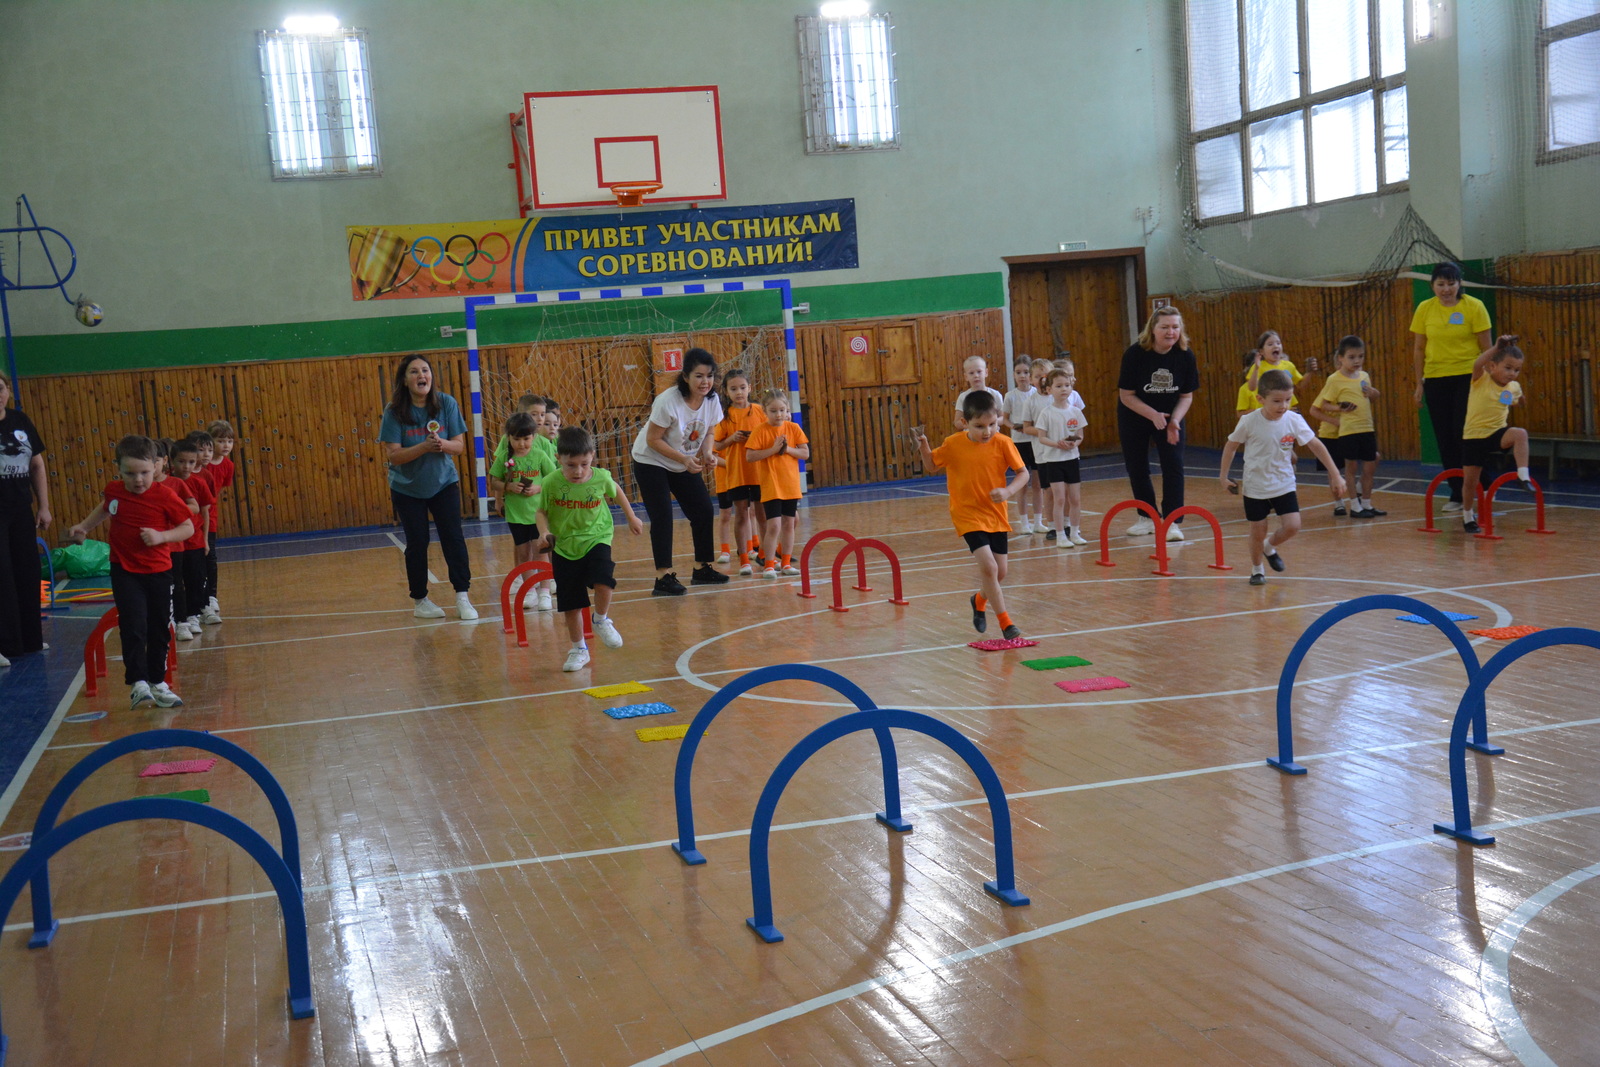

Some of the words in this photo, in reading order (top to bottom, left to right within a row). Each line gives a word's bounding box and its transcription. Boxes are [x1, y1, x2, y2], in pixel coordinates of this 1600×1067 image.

[543, 224, 648, 251] ПРИВЕТ
[656, 212, 841, 244] УЧАСТНИКАМ
[577, 237, 814, 277] СОРЕВНОВАНИЙ!
[555, 499, 602, 509] КРЕПЫШИ
